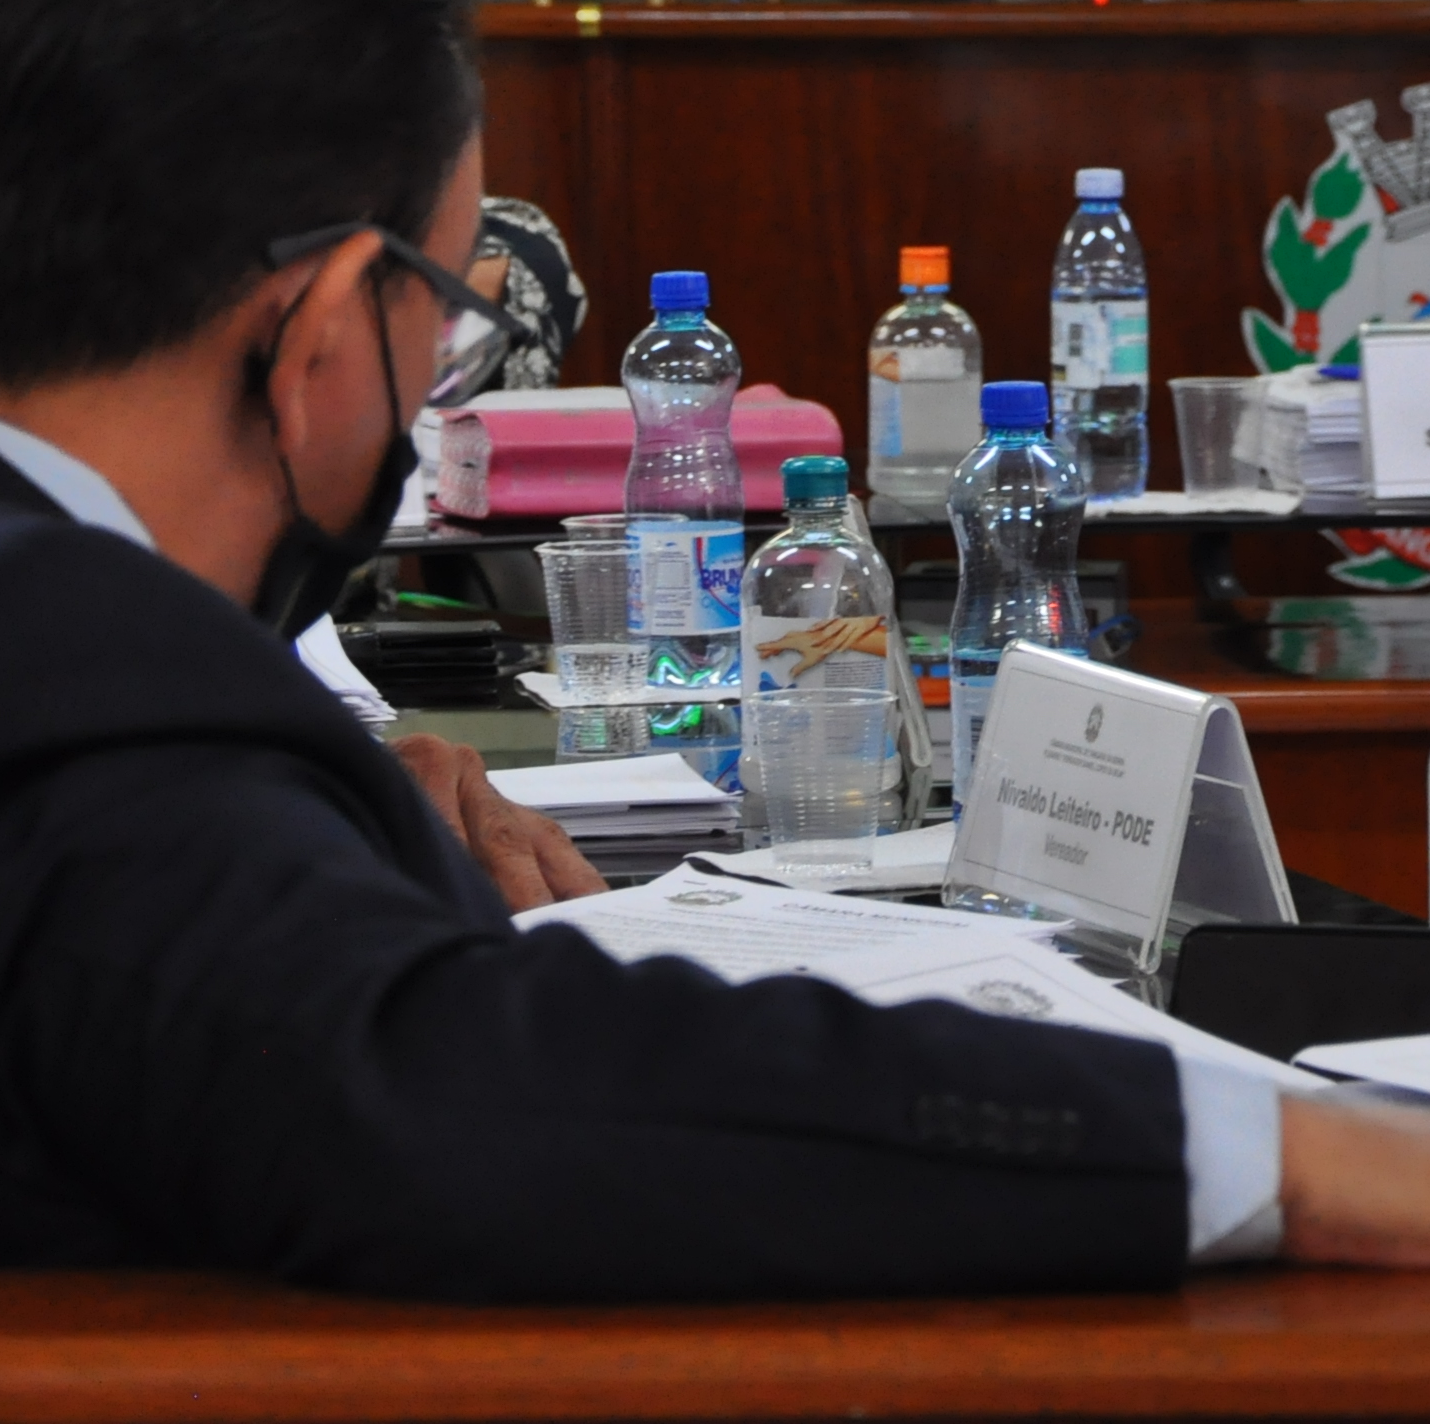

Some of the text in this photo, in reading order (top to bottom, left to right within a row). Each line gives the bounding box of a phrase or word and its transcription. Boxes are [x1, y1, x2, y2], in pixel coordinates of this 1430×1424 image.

[997, 777, 1048, 816] Nivaldo
[1048, 790, 1101, 832] Leiteiro
[1111, 809, 1155, 847] PODE
[1043, 833, 1089, 866] Vereador
